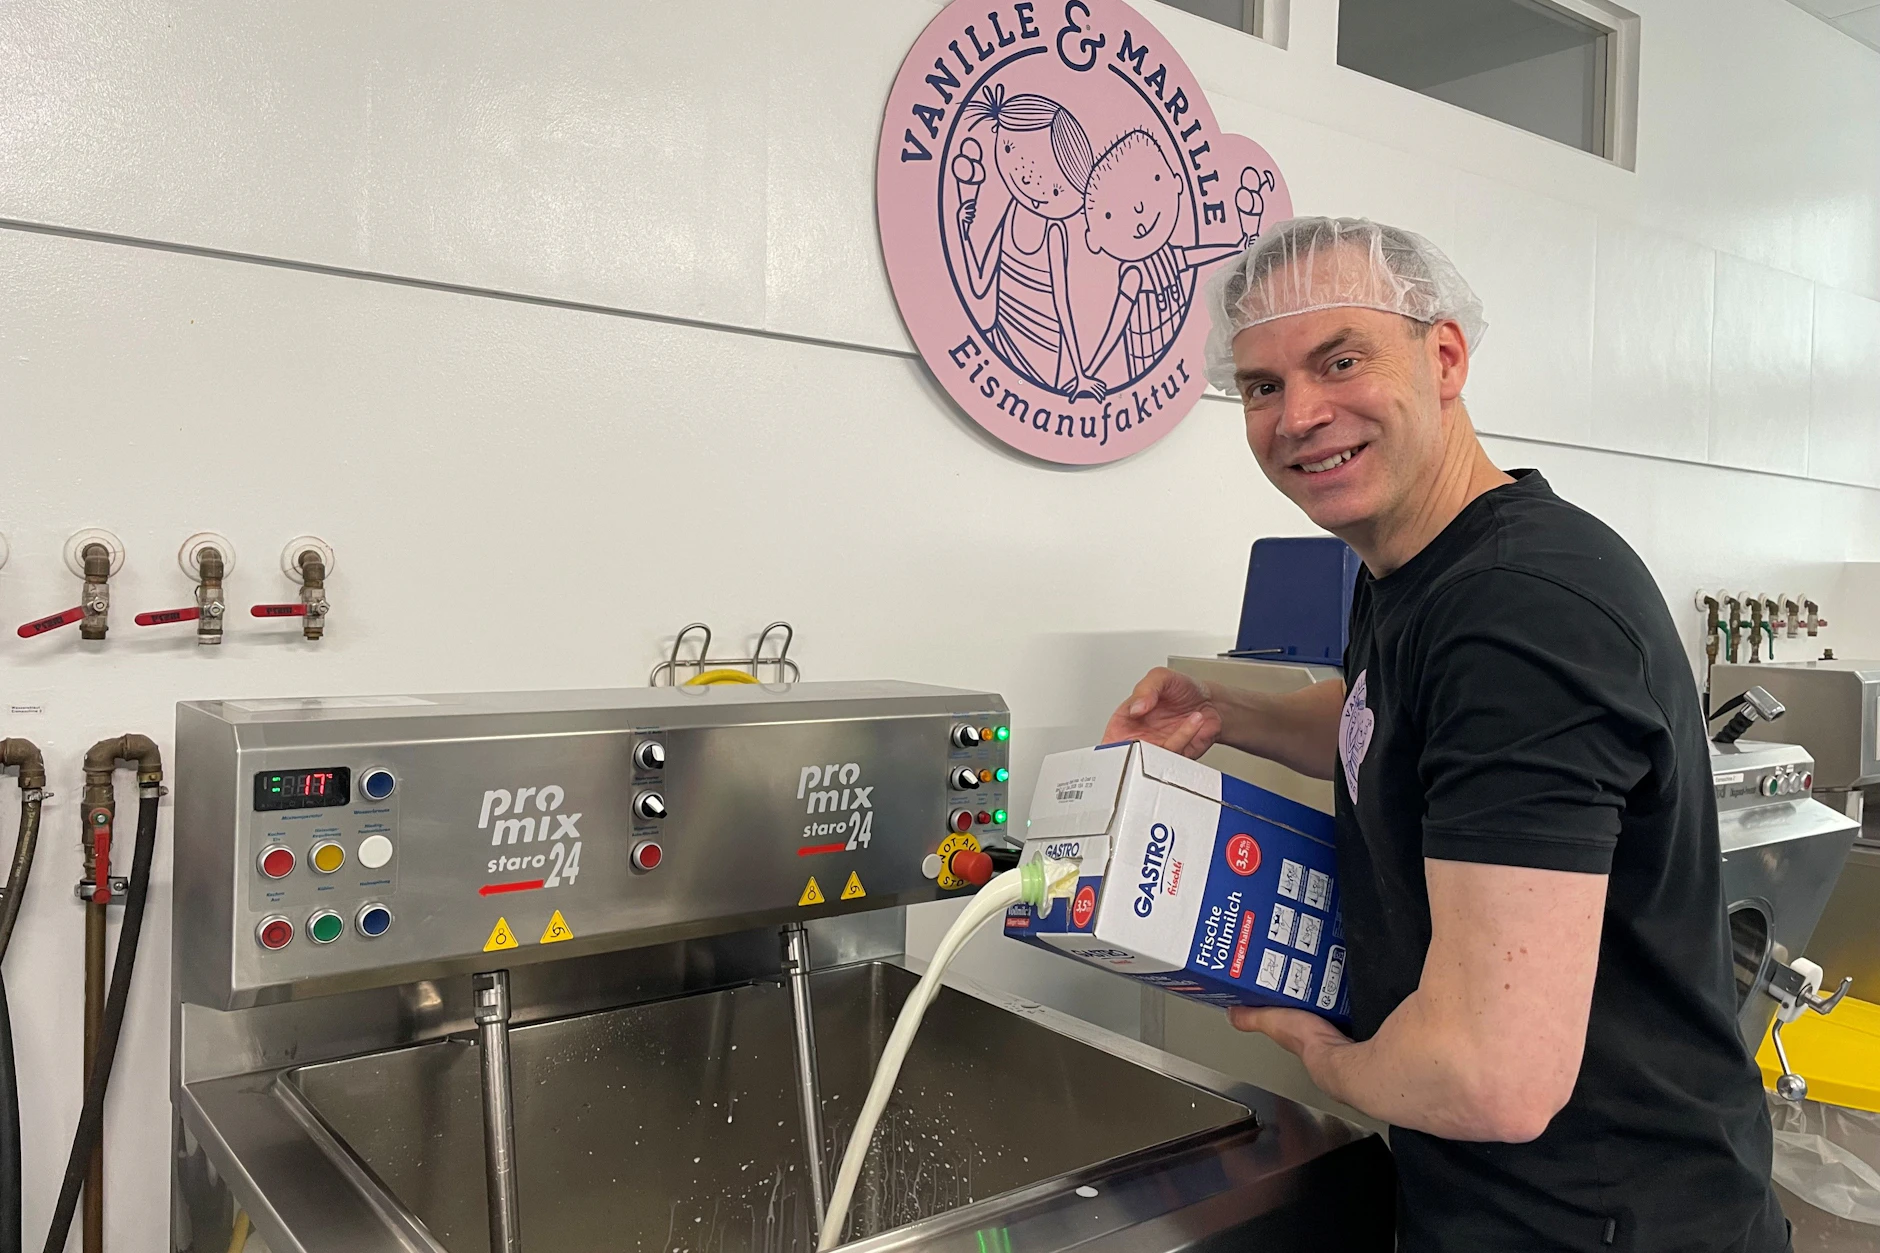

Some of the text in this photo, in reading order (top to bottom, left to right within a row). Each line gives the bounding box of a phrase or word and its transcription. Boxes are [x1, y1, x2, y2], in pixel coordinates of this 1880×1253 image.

[901, 0, 1226, 226] VANILLE & MARILLE
[948, 335, 1191, 446] Eismanufaktur
[797, 761, 860, 799] pro
[806, 786, 874, 814] mix
[478, 784, 564, 829] pro
[491, 814, 583, 846] mix
[803, 810, 874, 852] staro 24
[962, 838, 977, 852] AU
[1045, 842, 1080, 859] GASTRO
[488, 841, 583, 889] staro 24
[943, 876, 964, 887] STO
[1133, 822, 1169, 918] GASTRO
[1195, 905, 1222, 967] Frische
[1210, 891, 1242, 971] Vollmilch
[1232, 914, 1253, 974] Länger haltbar
